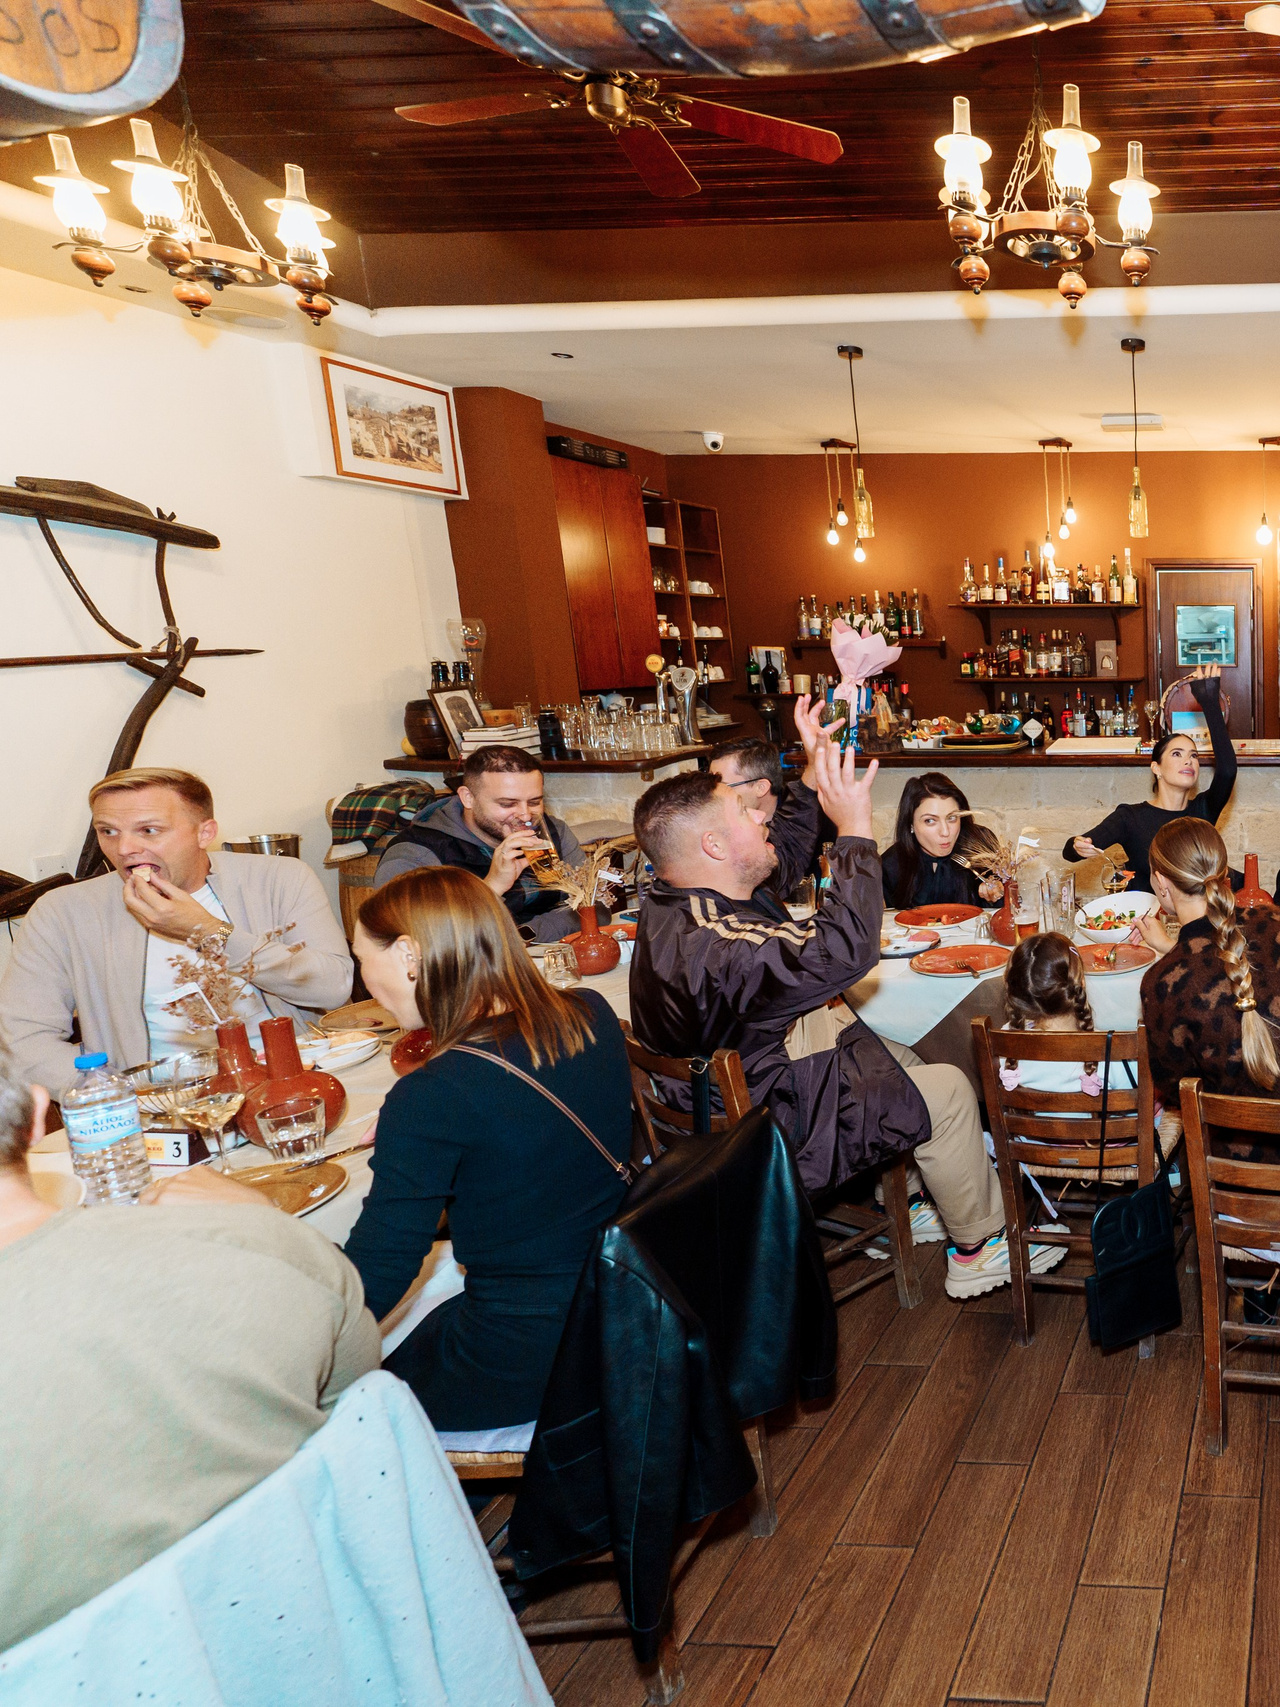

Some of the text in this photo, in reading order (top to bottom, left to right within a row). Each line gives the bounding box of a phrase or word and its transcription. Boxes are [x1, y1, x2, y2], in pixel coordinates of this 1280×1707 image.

[79, 1117, 136, 1136] ΝΙΚΟΛΑΟΣ
[92, 1115, 123, 1126] ΑΓΙΟΣ
[172, 1141, 182, 1157] 3
